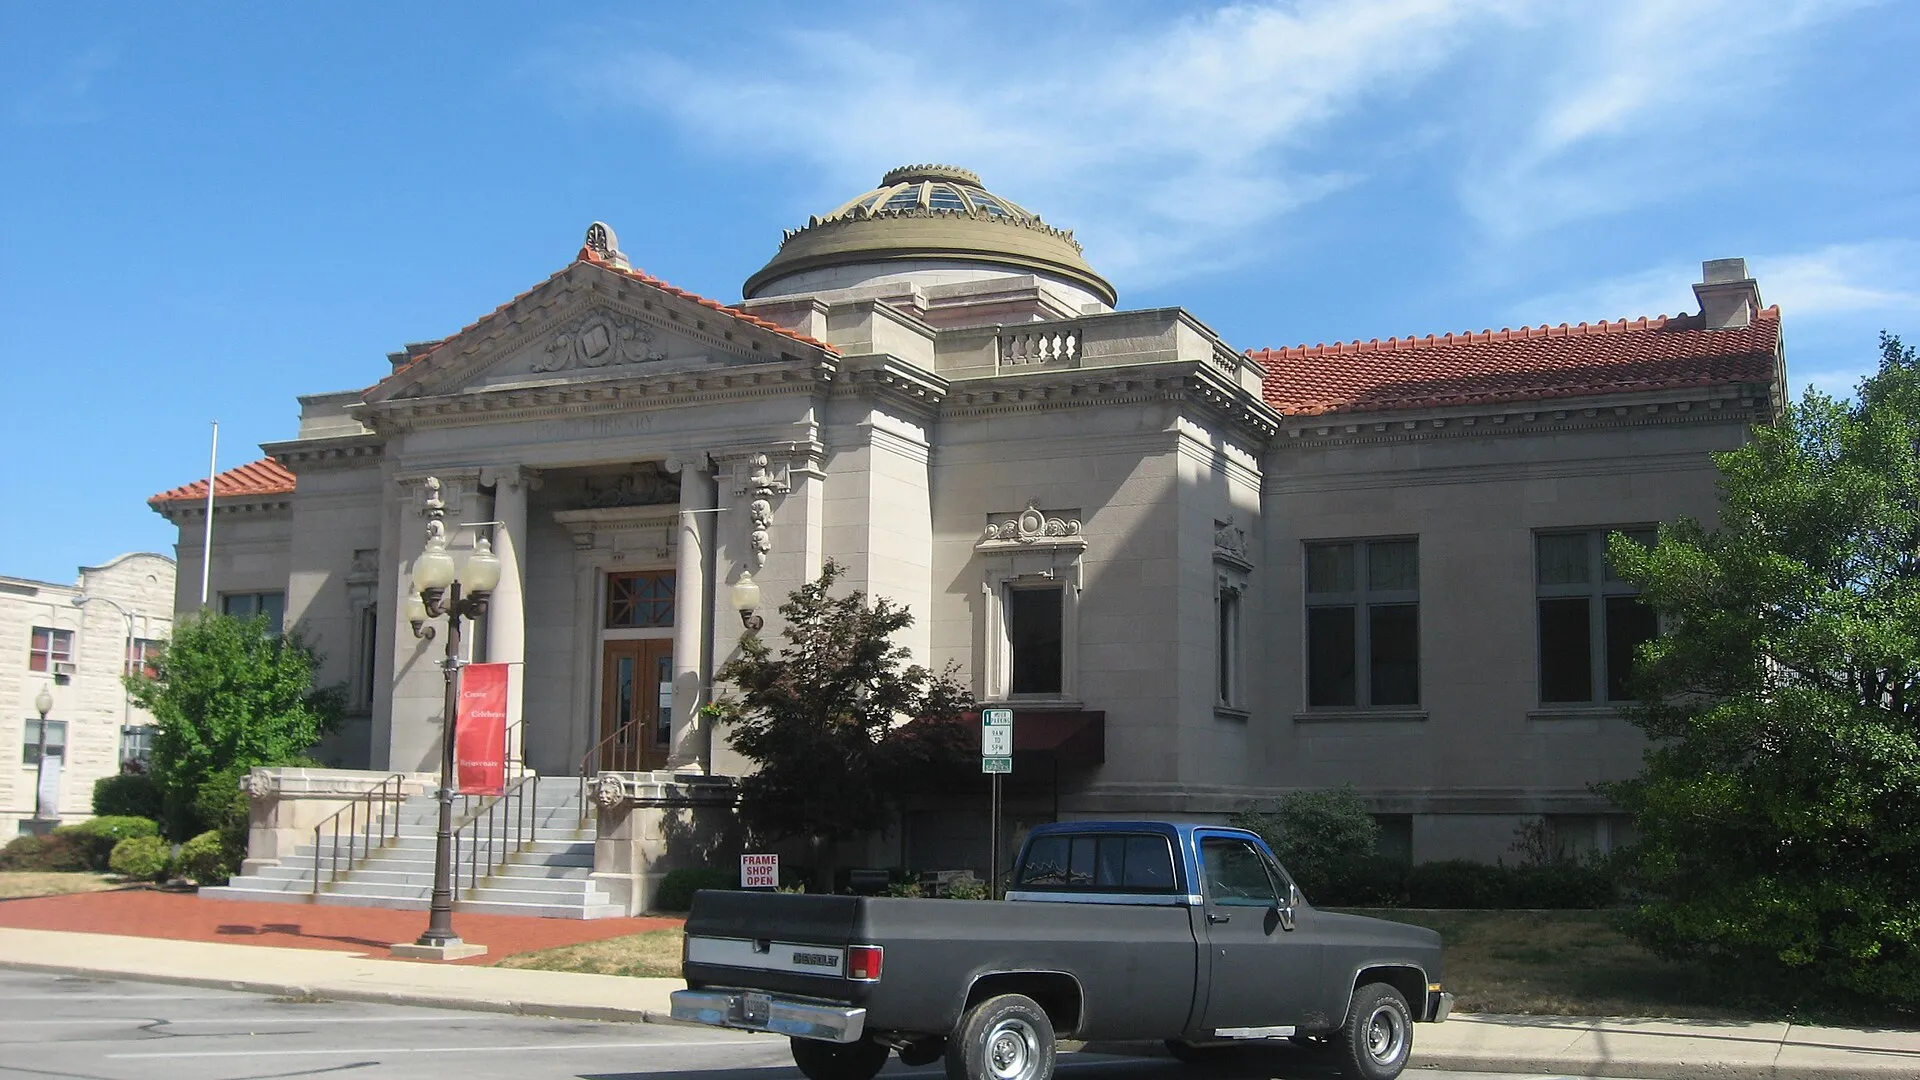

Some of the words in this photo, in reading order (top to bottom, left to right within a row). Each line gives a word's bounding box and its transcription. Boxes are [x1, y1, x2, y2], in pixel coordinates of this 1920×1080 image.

[471, 709, 505, 719] Celebrate
[460, 759, 498, 768] Rejuvenate
[742, 855, 777, 865] FRAME
[746, 866, 773, 875] SHOP
[746, 876, 774, 886] OPEN
[793, 952, 839, 967] CHEVROLET
